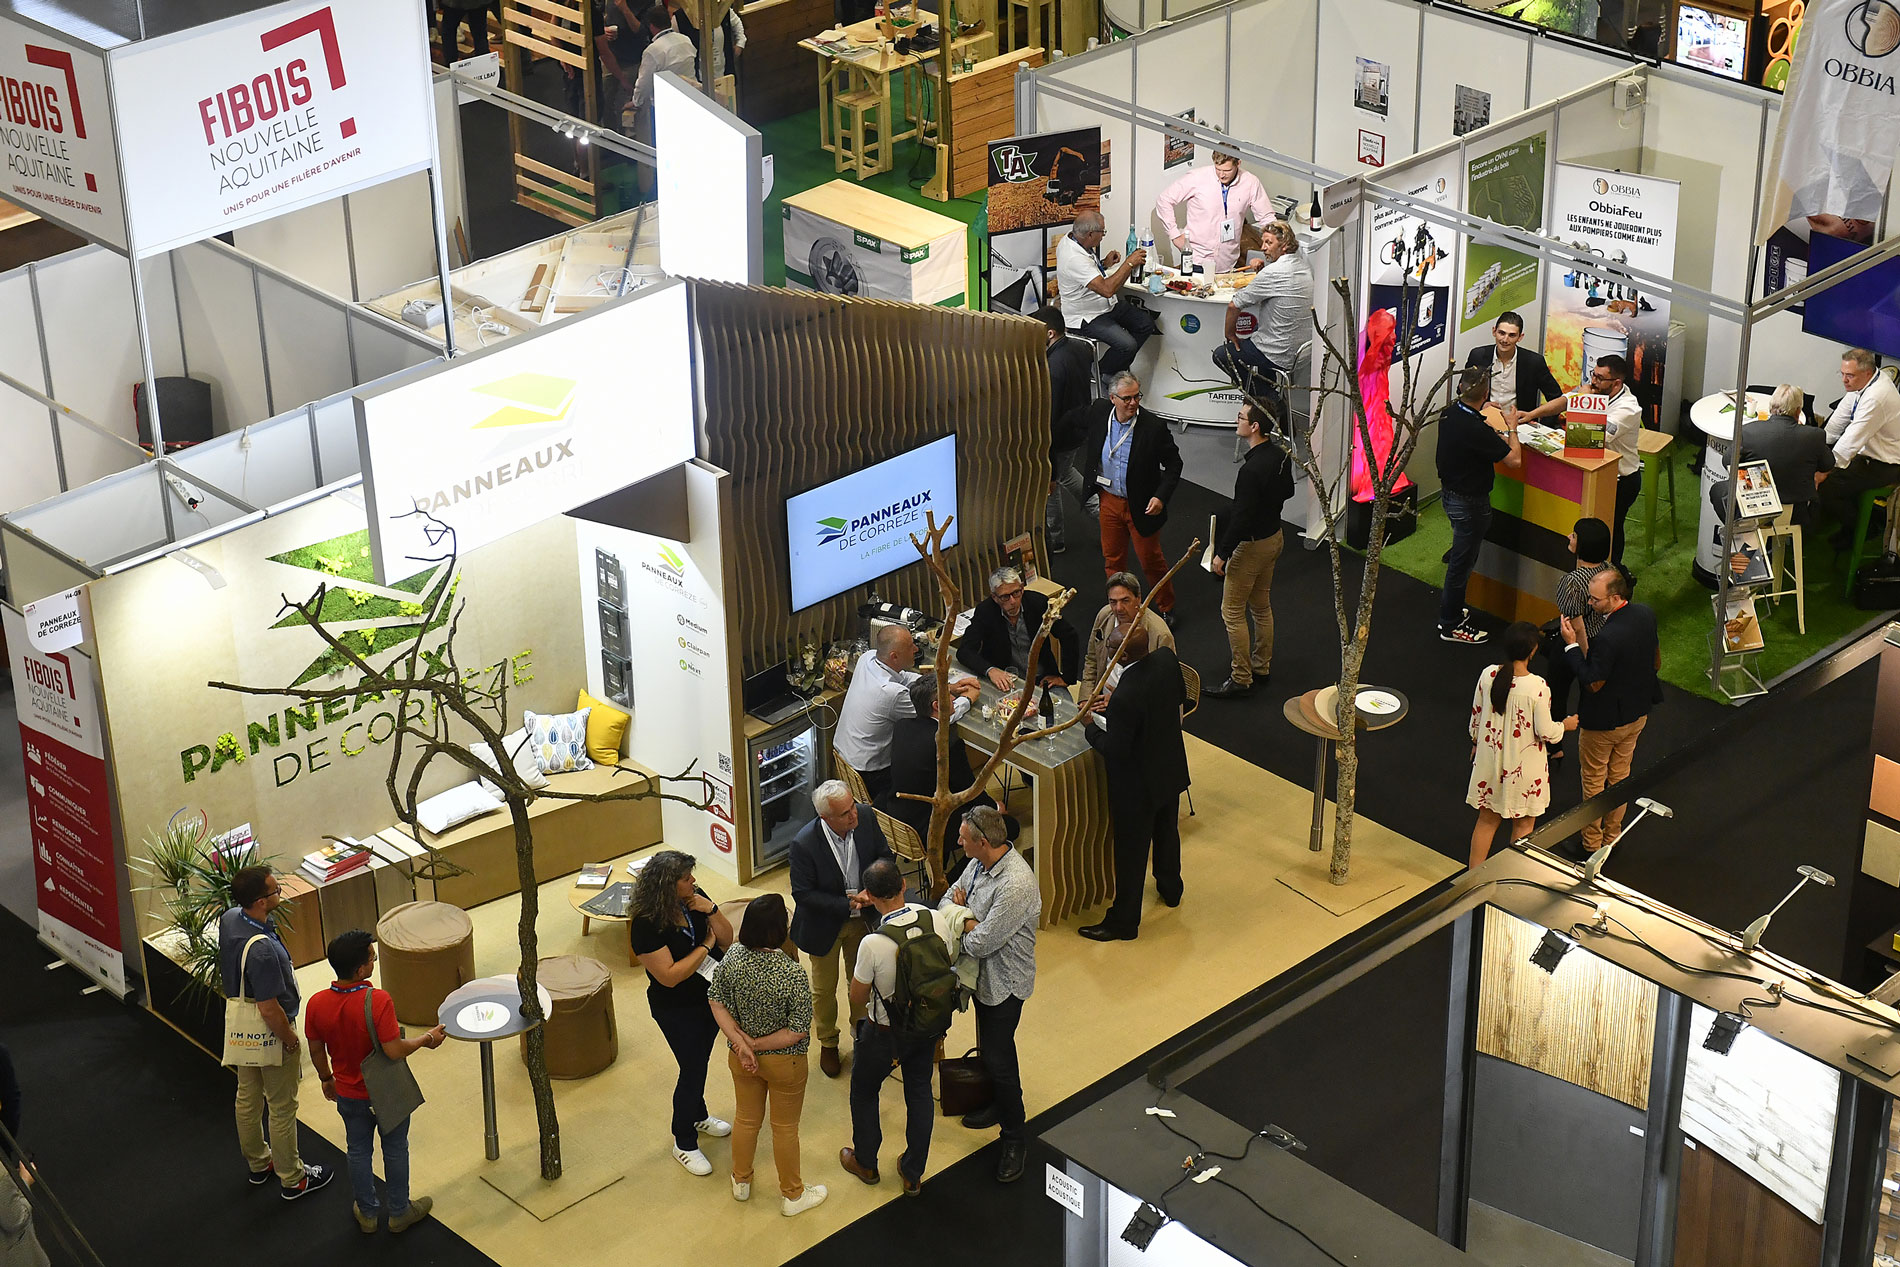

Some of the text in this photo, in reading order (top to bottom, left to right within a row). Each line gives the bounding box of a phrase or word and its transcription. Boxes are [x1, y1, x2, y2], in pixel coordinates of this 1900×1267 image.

[1824, 58, 1896, 96] OBBIA
[0, 75, 63, 133] IBOIS
[198, 58, 312, 146] FIBOIS
[0, 127, 70, 161] NOUVELLE
[210, 106, 319, 171] NOUVELLE
[9, 153, 75, 187] AQUITAINE
[219, 131, 324, 195] AQUITAINE
[1471, 160, 1488, 172] Encore
[1500, 160, 1510, 170] bois
[223, 147, 361, 216] UNIS POUR UNE FILIÈRE D'AVENIR
[1610, 183, 1641, 197] OBBIA
[1589, 200, 1643, 220] ObbiaFeu
[1374, 222, 1392, 232] comme
[1567, 213, 1662, 238] LES ENFANTS NE JOUERONT PLUS
[1569, 223, 1582, 233] AUX
[1582, 226, 1613, 239] POMPIERS
[1614, 231, 1636, 243] COMME
[1636, 235, 1655, 247] AVANT
[855, 234, 877, 248] SPAX
[903, 249, 925, 260] SPAX
[1570, 396, 1606, 411] BOIS
[416, 438, 574, 519] PANNEAUX
[851, 489, 932, 532] PANNEAUX
[839, 508, 919, 551] DE CORREZE
[860, 551, 870, 560] LA
[871, 542, 892, 556] FIBRE
[893, 537, 903, 547] DE
[641, 561, 684, 589] PANNEAUX
[37, 616, 82, 639] DE CORREZE
[39, 610, 77, 630] PANNEAUX
[685, 618, 708, 635] Medium
[686, 641, 711, 658] Clairpan
[23, 655, 64, 695] FIBOIS
[27, 683, 67, 709] NOUVELLE
[32, 697, 69, 723] AQUITAINE
[273, 737, 331, 788] DE
[1048, 1184, 1081, 1210] ACOUSTIQUE
[1052, 1174, 1078, 1196] ACOUSTIC
